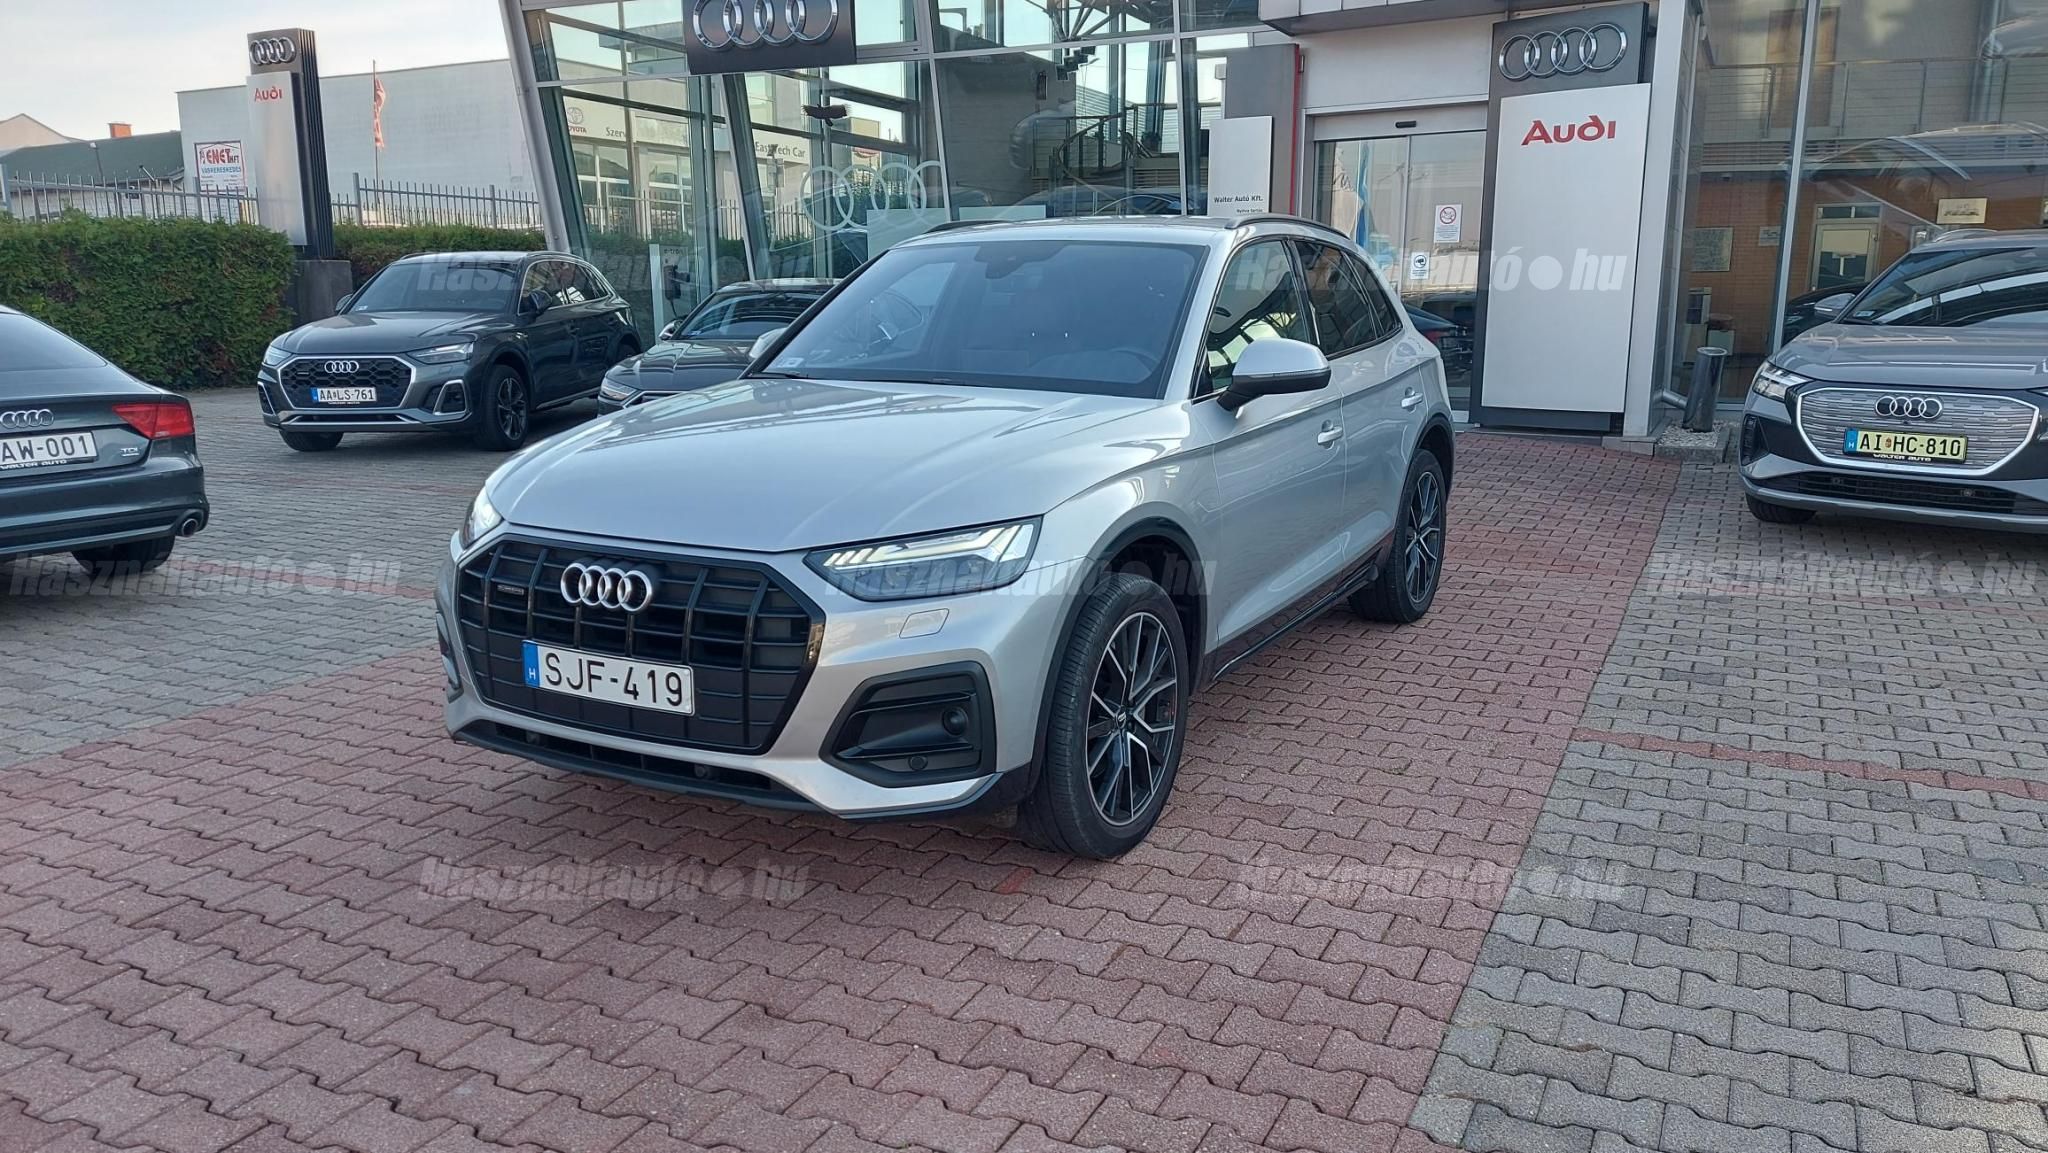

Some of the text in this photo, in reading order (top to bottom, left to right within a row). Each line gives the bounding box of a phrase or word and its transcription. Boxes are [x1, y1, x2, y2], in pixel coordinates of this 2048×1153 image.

[254, 86, 282, 101] Audi
[1521, 115, 1616, 145] Audi
[792, 147, 805, 157] Car
[528, 667, 536, 681] H
[545, 652, 683, 706] SJF-419
